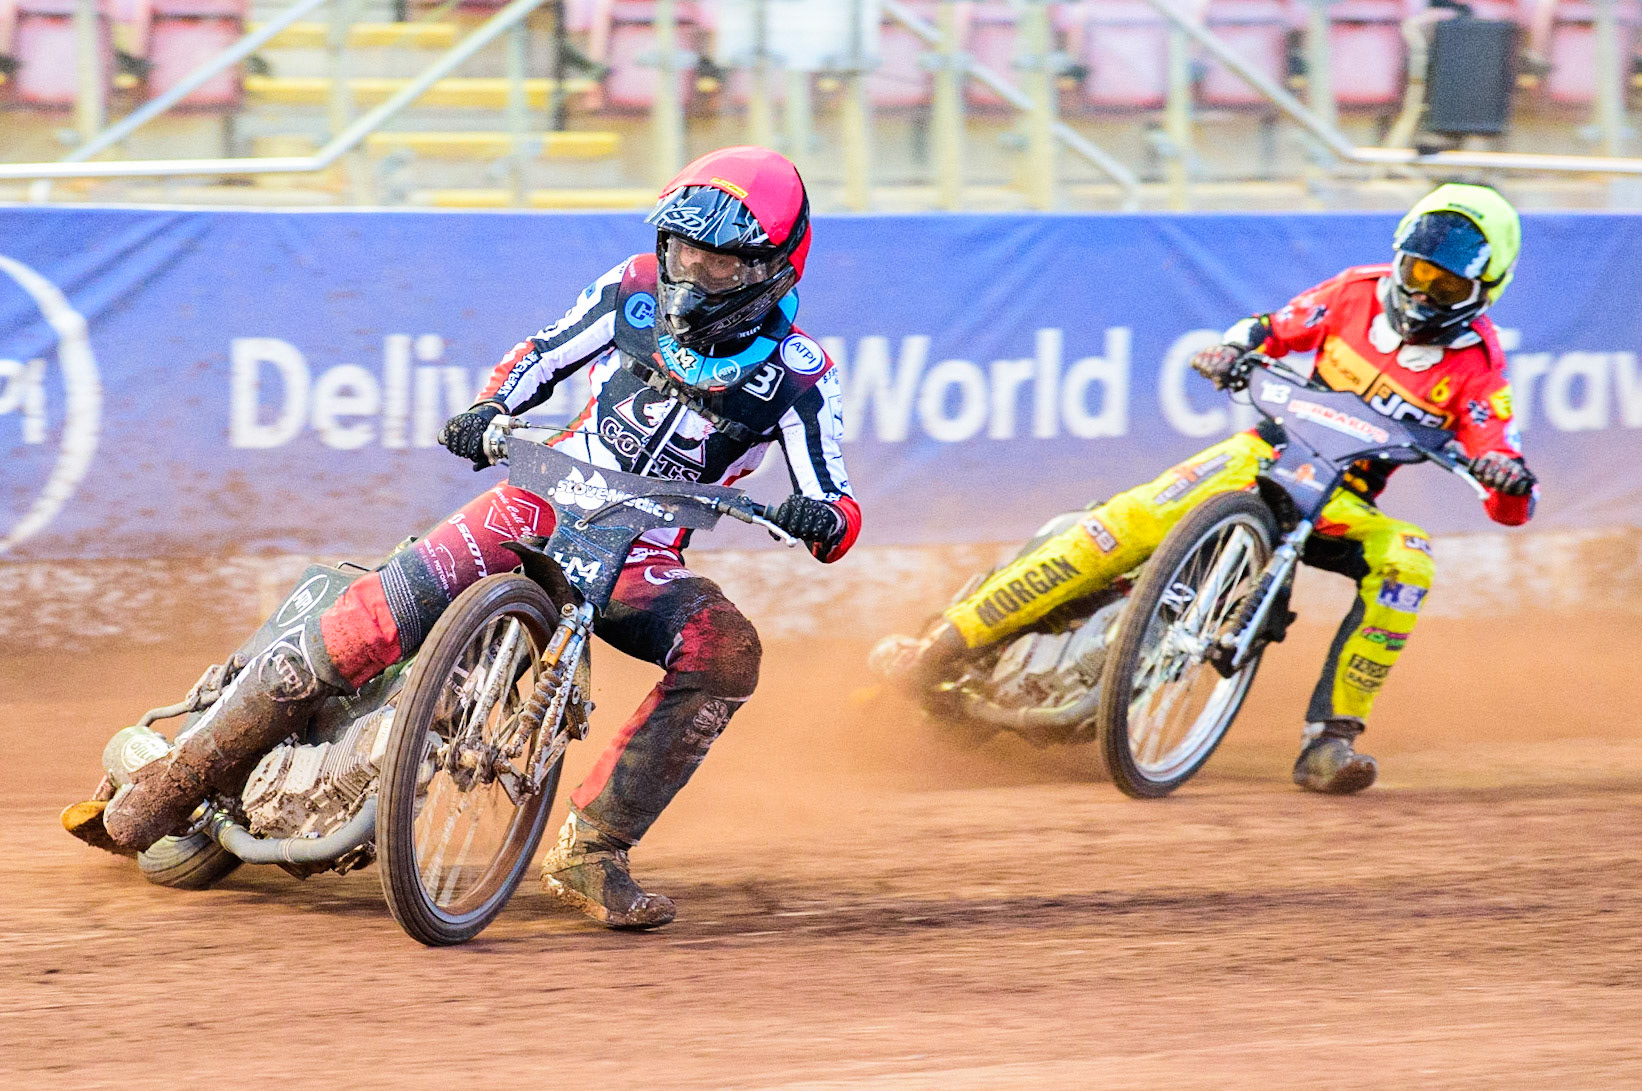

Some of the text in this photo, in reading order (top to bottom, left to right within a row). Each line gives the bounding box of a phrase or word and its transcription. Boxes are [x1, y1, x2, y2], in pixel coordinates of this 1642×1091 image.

[789, 341, 817, 365] ATPI
[1430, 376, 1450, 403] 6
[455, 522, 488, 579] SCOTT
[975, 553, 1083, 629] MORGAN
